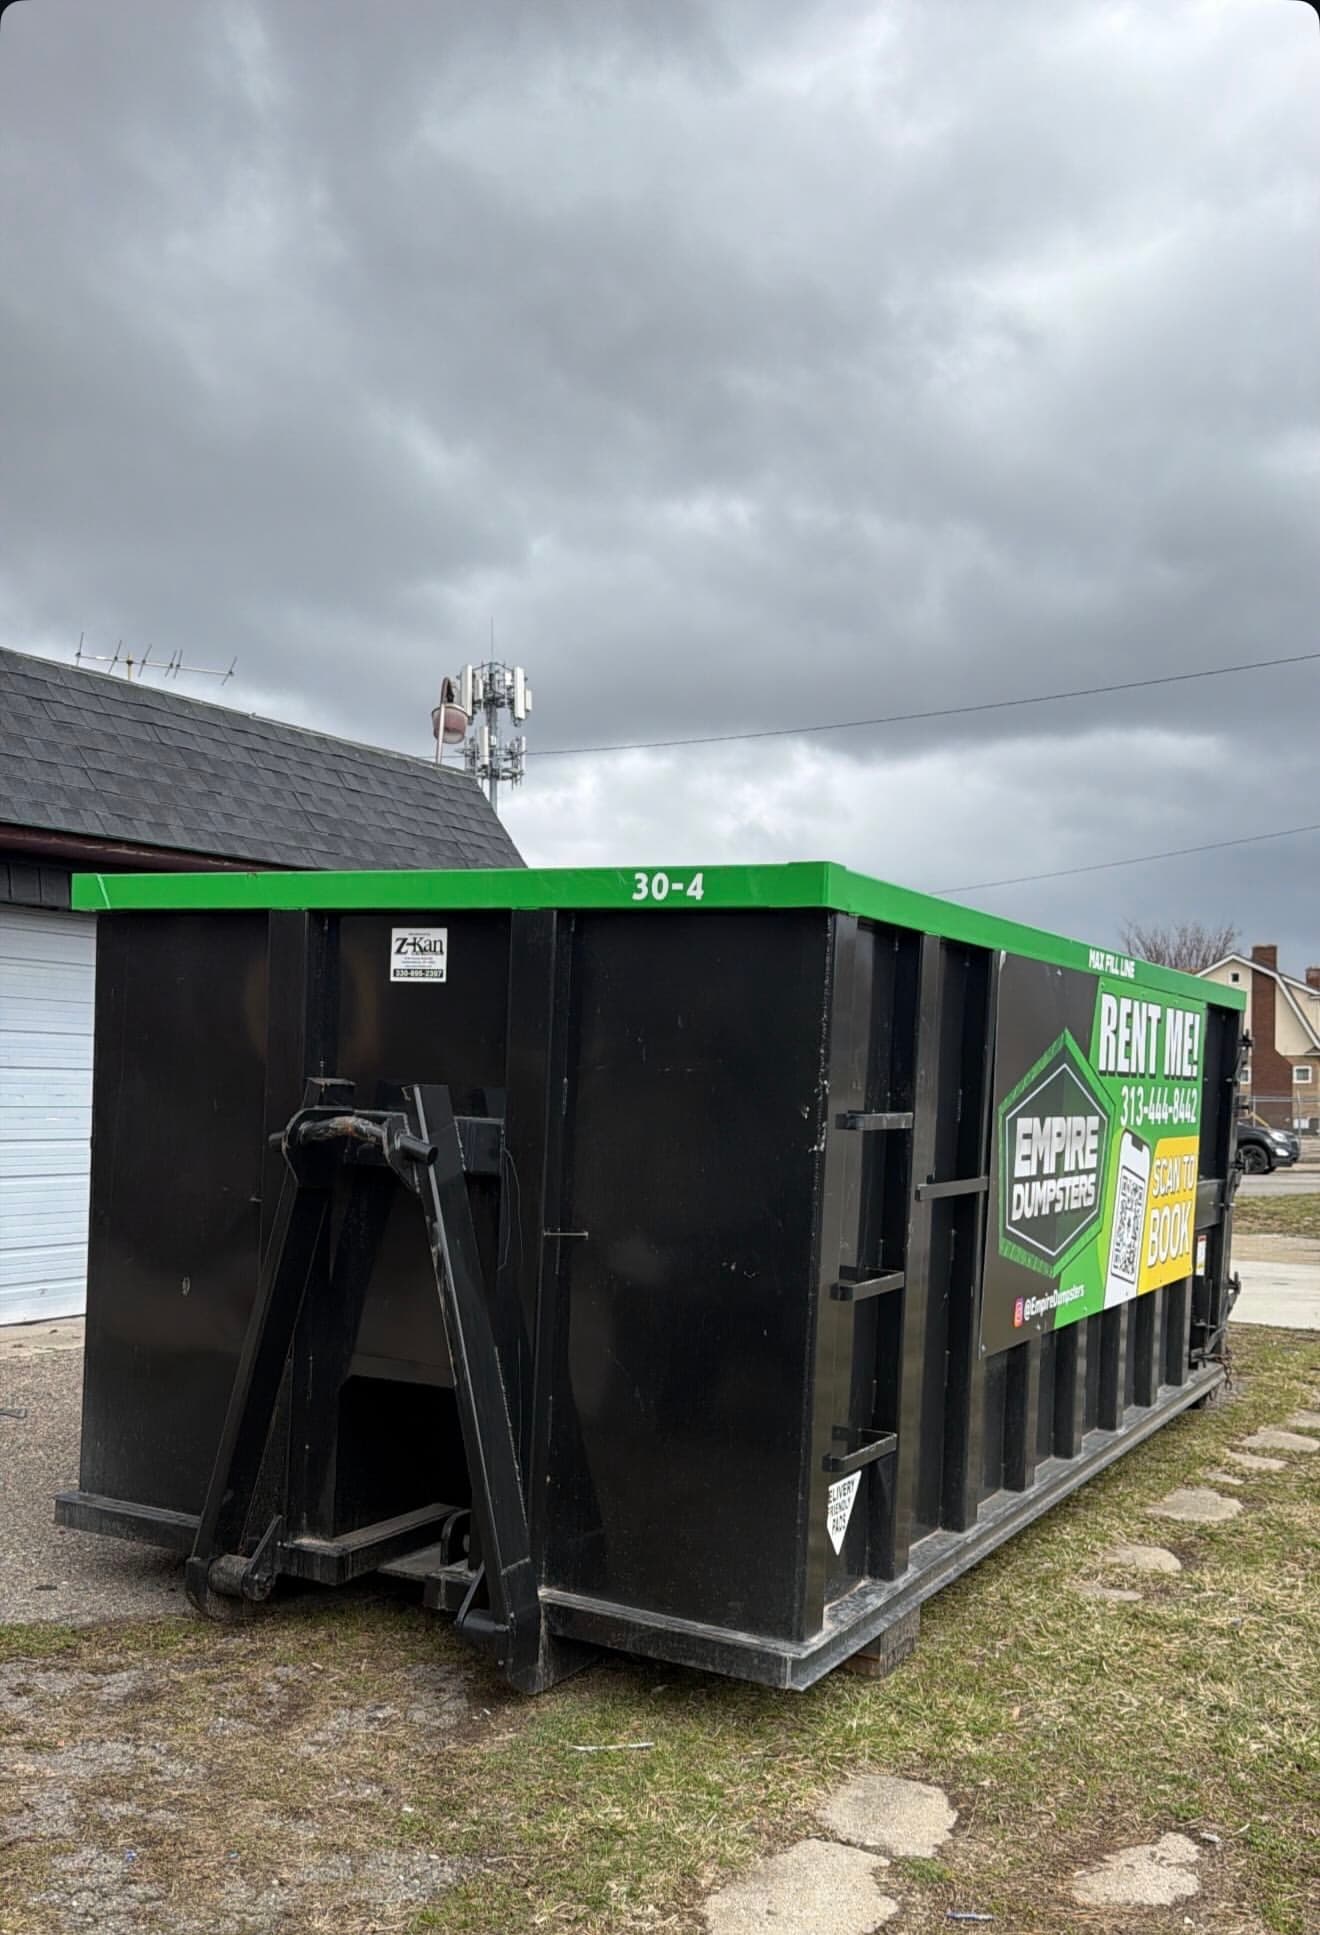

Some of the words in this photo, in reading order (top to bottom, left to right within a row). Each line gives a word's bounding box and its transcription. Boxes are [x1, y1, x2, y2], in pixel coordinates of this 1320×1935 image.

[632, 872, 704, 901] 30-4
[394, 937, 444, 956] Z-Kan
[1088, 948, 1104, 971] MAX
[1104, 954, 1119, 976] FILL
[1120, 956, 1136, 979] LINE
[1098, 992, 1161, 1078] RENT
[1163, 1007, 1201, 1079] ME!
[1120, 1084, 1198, 1127] 313-444-8442
[1014, 1115, 1100, 1178] EMPIRE
[1011, 1173, 1098, 1222] DUMPSTERS
[1151, 1154, 1182, 1199] SCAN
[1182, 1153, 1196, 1191] TO
[1147, 1206, 1192, 1269] BOOK
[1024, 1283, 1085, 1323] @EmpireDumpsters
